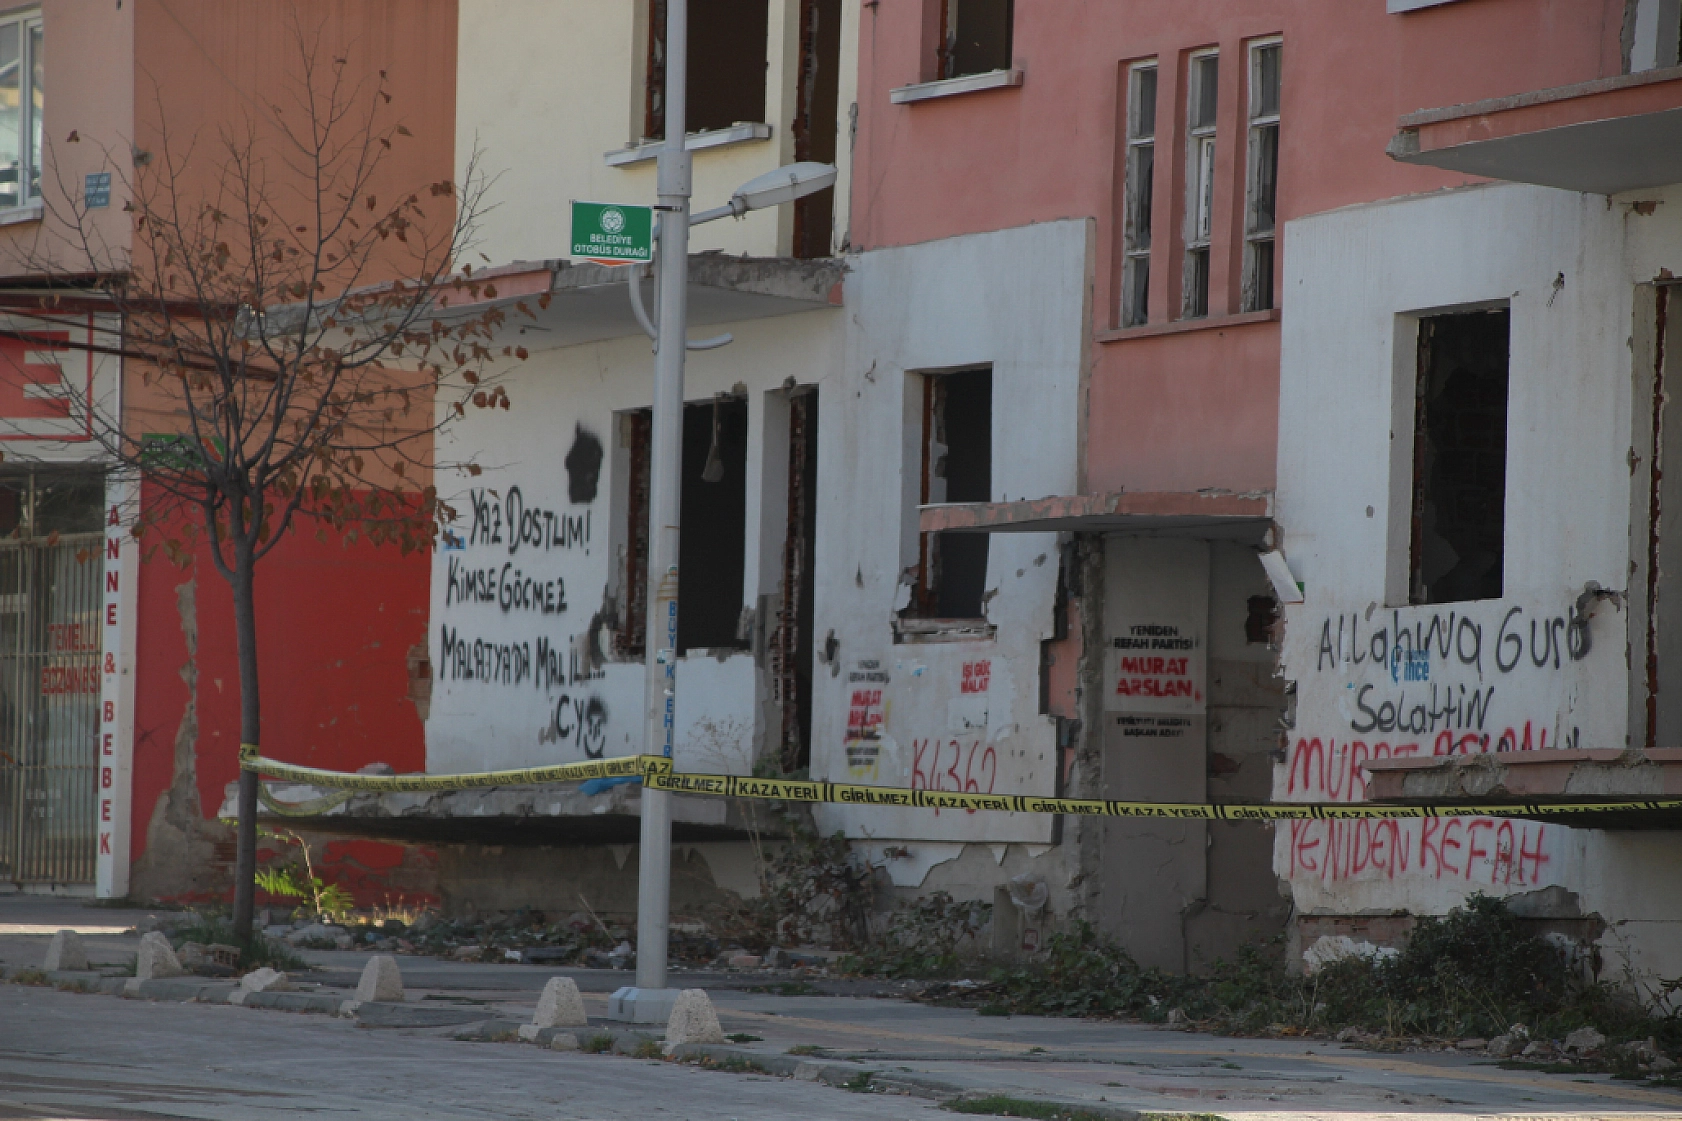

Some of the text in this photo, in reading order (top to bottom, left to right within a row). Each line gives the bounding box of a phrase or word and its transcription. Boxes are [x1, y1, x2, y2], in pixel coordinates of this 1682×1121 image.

[590, 233, 631, 245] BELEDİYE
[574, 244, 648, 257] OTOBÜS DURAĞI
[105, 504, 120, 627] ANNE
[1120, 656, 1188, 676] MURAT
[1115, 677, 1193, 697] ARSLAN
[99, 700, 115, 855] BEBEK
[738, 781, 781, 797] KAZA
[839, 787, 909, 806] GİRİLMEZ
